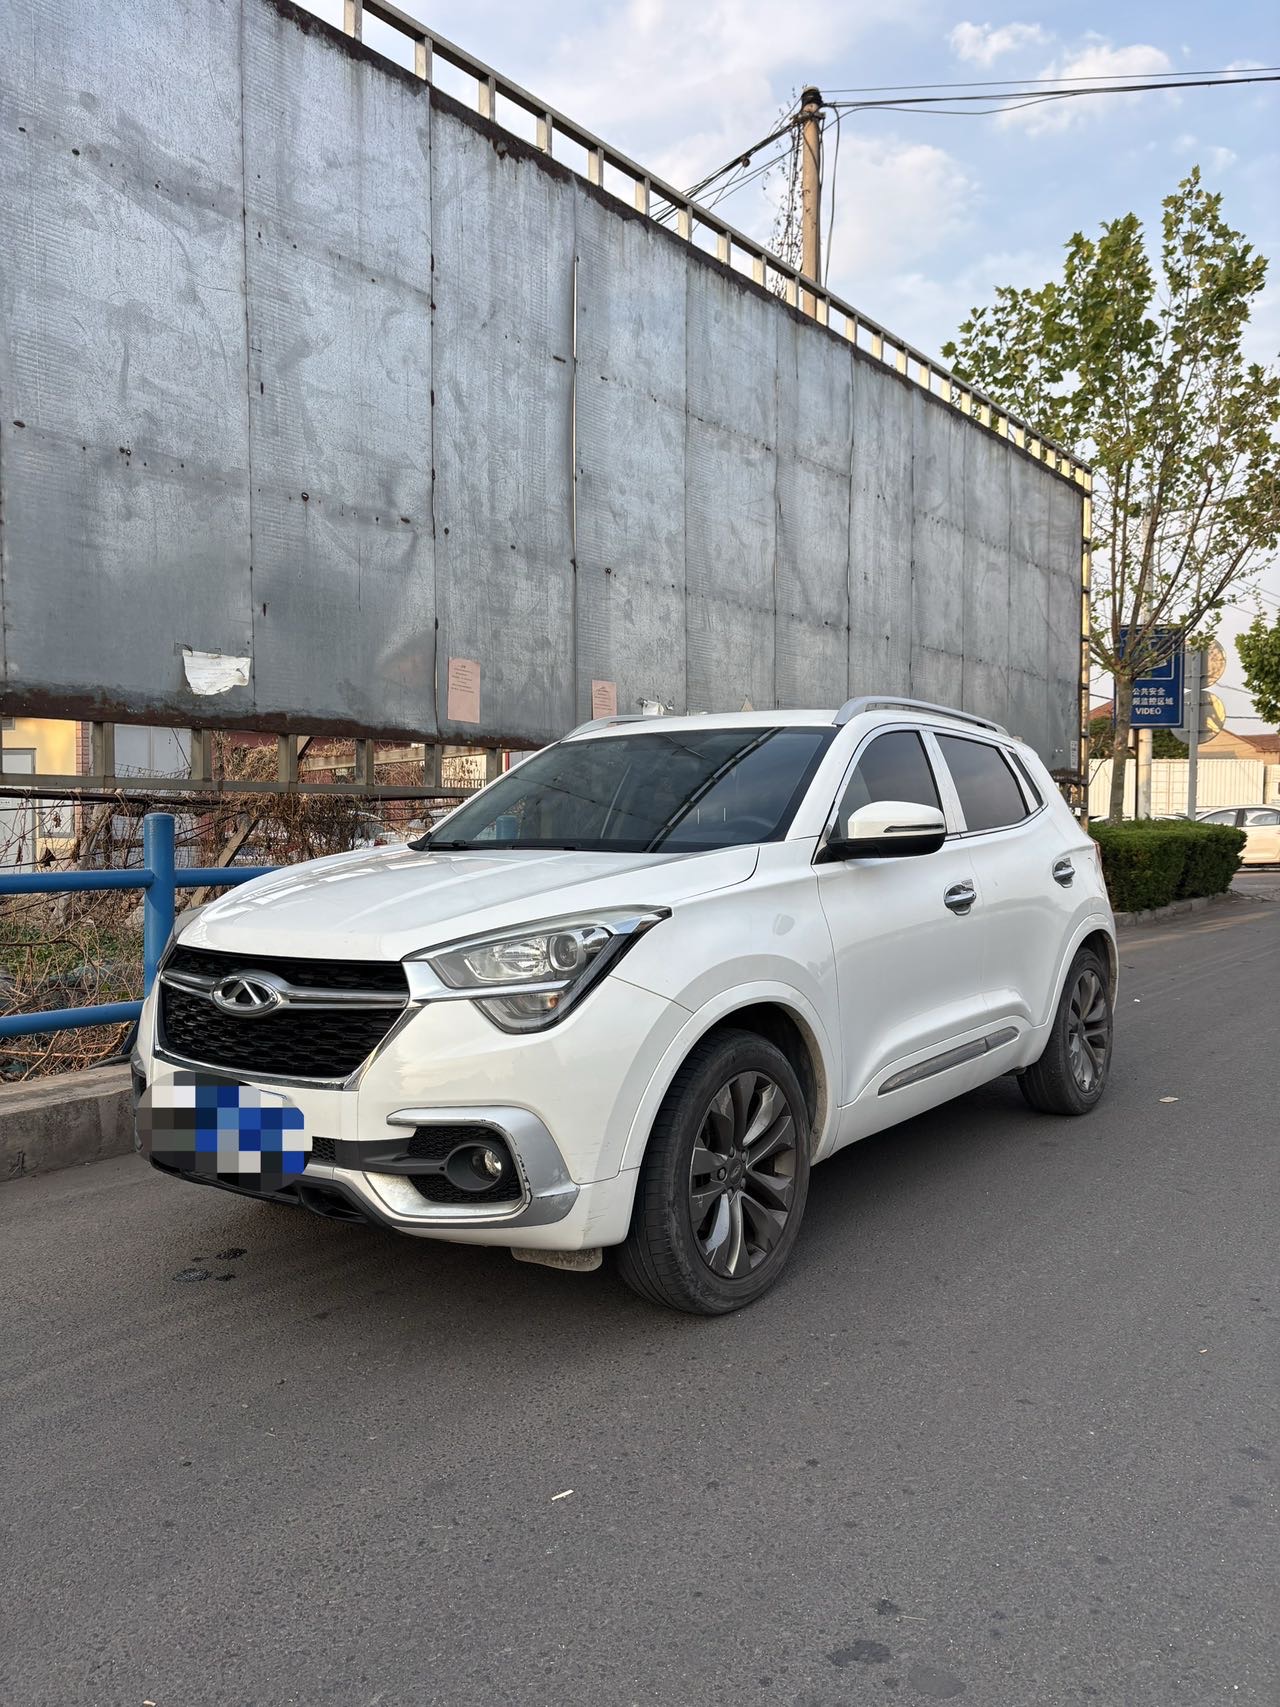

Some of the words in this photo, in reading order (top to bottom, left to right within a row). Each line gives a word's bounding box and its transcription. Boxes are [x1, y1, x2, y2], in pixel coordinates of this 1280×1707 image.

[1132, 687, 1166, 696] 公共安全
[1132, 697, 1174, 706] 频监控区域
[1135, 707, 1162, 715] VIDEO
